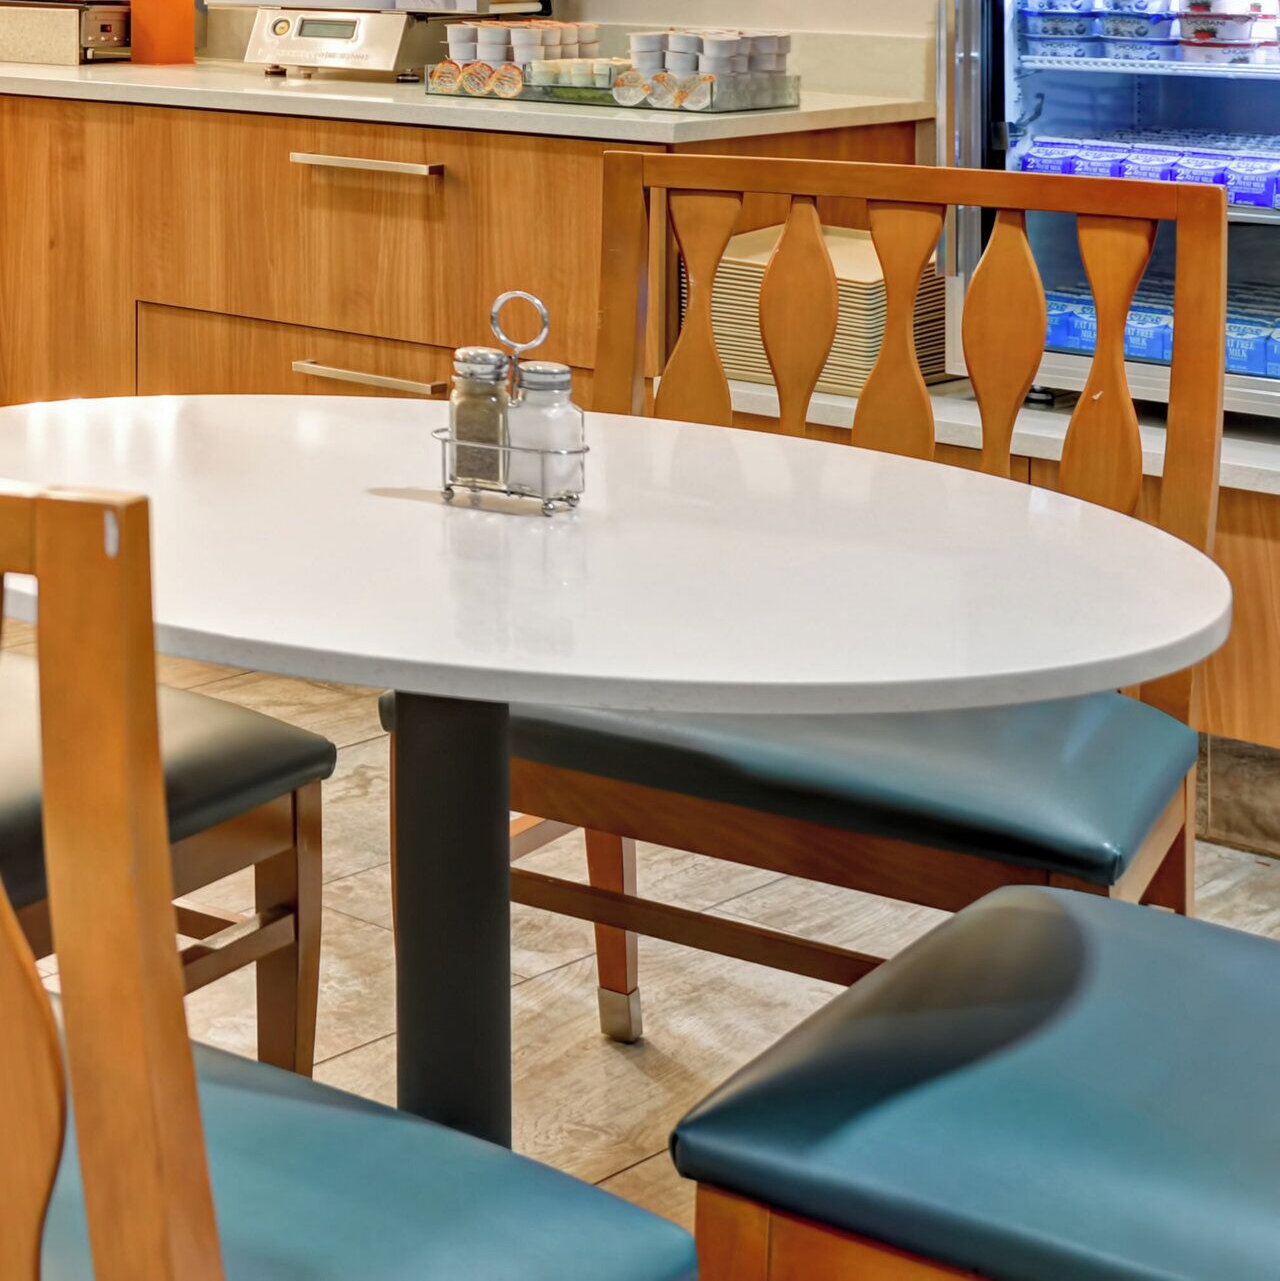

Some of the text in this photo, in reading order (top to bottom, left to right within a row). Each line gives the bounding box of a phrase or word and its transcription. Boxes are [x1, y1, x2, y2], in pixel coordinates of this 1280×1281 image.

[1074, 320, 1087, 330] FAT
[1137, 329, 1154, 338] FREE
[1130, 336, 1147, 346] MILK
[1236, 339, 1255, 350] FREE
[1229, 348, 1247, 358] MILK
